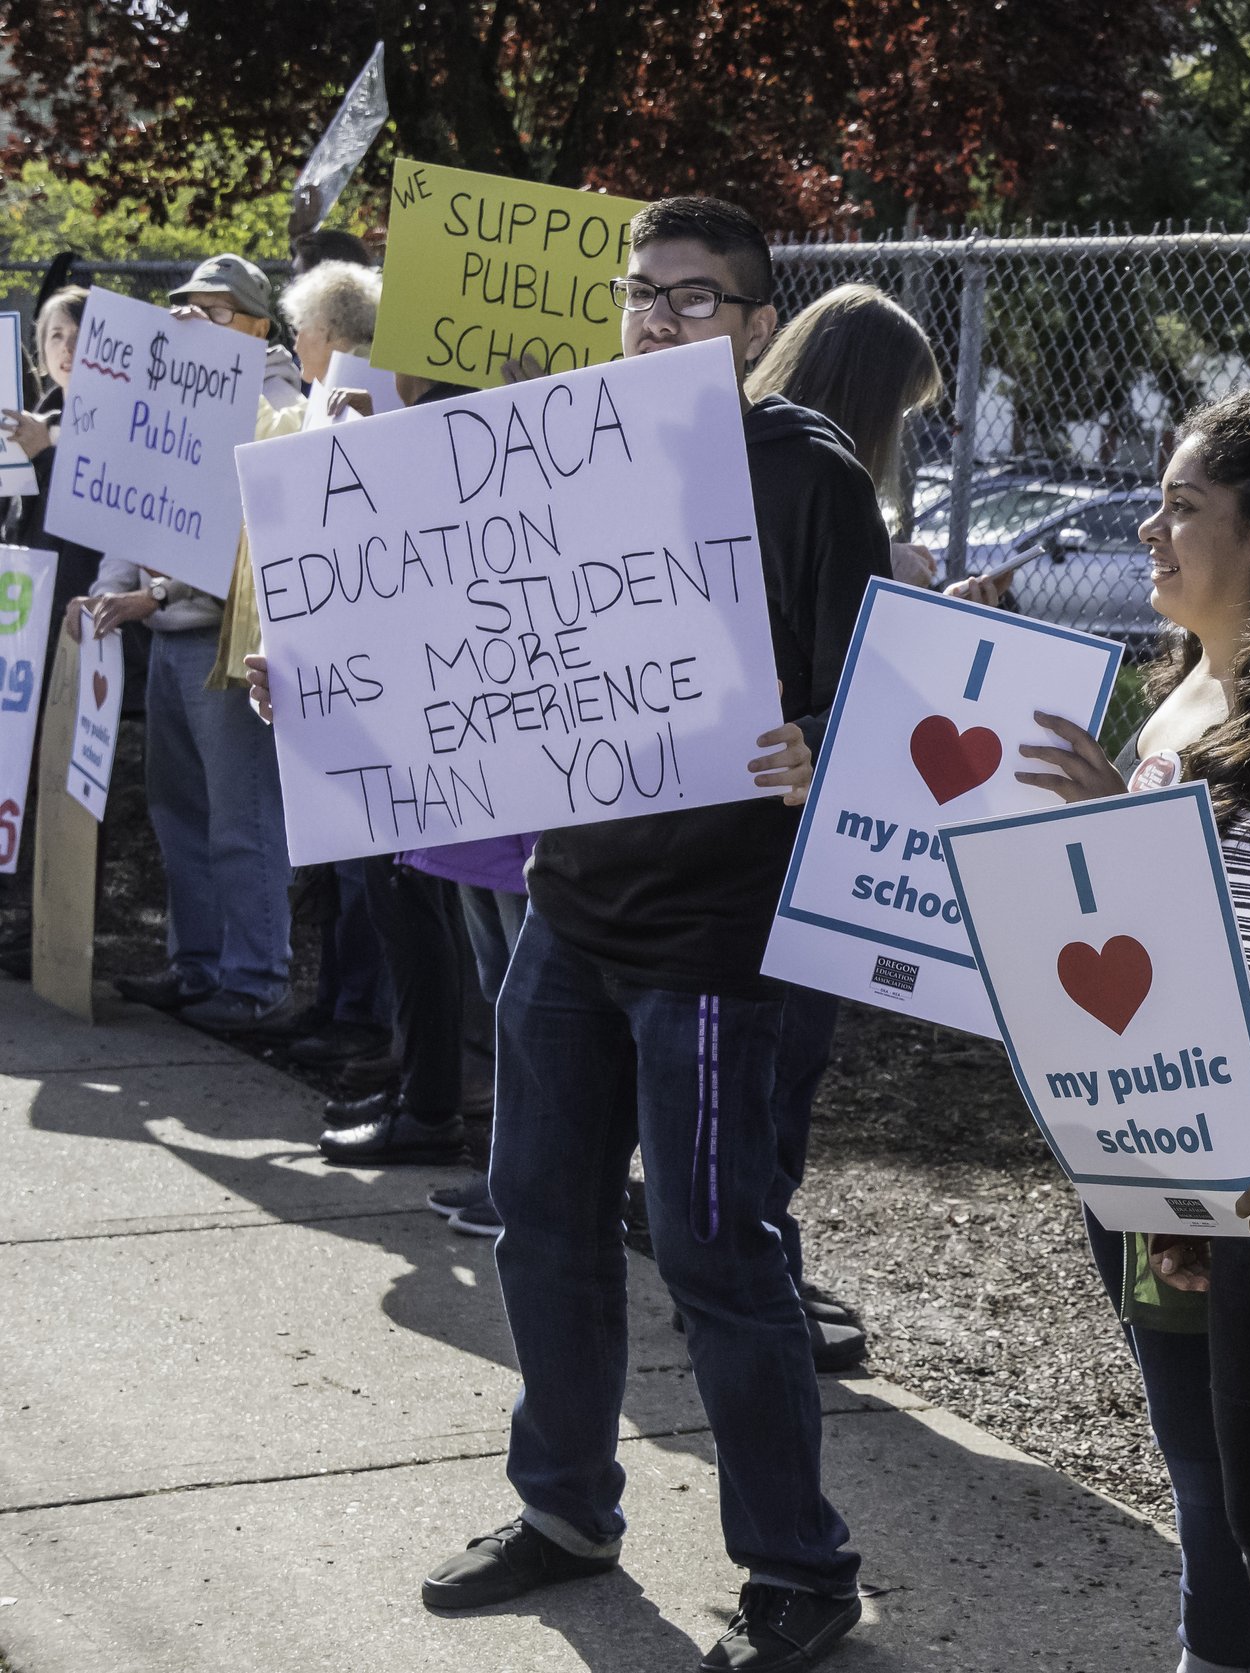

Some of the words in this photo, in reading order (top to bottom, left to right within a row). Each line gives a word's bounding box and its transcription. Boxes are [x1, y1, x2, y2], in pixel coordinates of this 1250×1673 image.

[394, 169, 432, 209] WE
[444, 192, 631, 265] SUPPO
[462, 252, 609, 324] PUBLIC
[85, 316, 134, 369] More
[148, 330, 243, 407] $upport
[72, 396, 98, 435] for
[129, 400, 202, 465] Public
[323, 435, 377, 527] A
[443, 377, 632, 504] DACA
[72, 455, 202, 539] Education
[261, 504, 561, 622] EDUCATION
[466, 536, 752, 634] STUDENT
[297, 654, 383, 720] HAS
[425, 627, 591, 692] MORE
[424, 656, 703, 754] EXPERIENCE
[962, 639, 995, 702] I
[326, 759, 496, 843] THAN
[542, 722, 685, 814] YOU!
[836, 808, 898, 853] my
[851, 871, 962, 925] schoo
[1066, 842, 1097, 915] I
[875, 967, 915, 983] EDUCATION
[878, 957, 918, 975] OREGON
[1046, 1070, 1099, 1106] my
[1111, 1046, 1232, 1105] public
[1096, 1112, 1214, 1155] school
